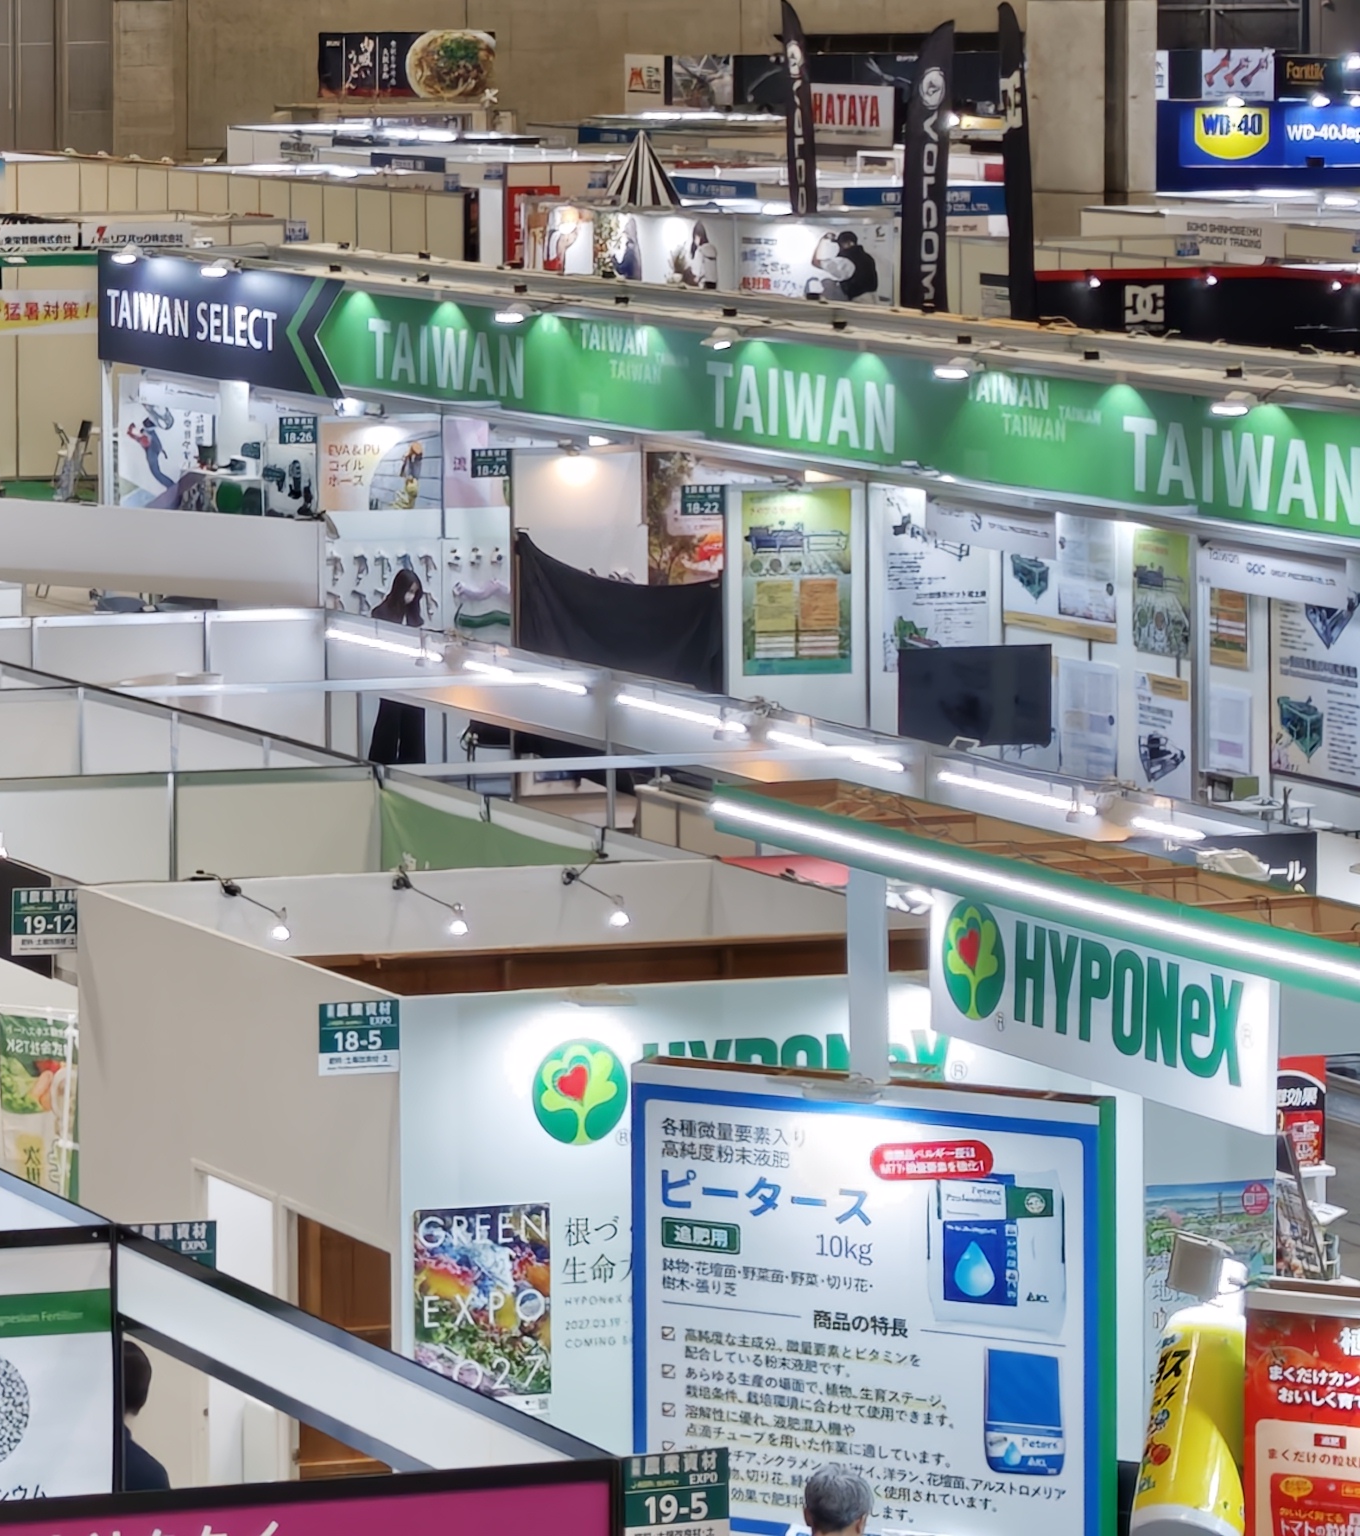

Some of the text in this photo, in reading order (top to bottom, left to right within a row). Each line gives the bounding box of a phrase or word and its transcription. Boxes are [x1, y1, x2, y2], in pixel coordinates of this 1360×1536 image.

[1287, 60, 1326, 81] Fanttik
[812, 92, 880, 127] HATAYA
[1201, 114, 1263, 135] WD-40
[106, 287, 278, 352] TAIWAN SELECT
[579, 321, 649, 358] TAIWAN
[367, 317, 525, 400] TAIWAN
[967, 370, 1049, 410] TAIWAN
[705, 361, 896, 455] TAIWAN
[284, 431, 313, 443] 18-26
[1001, 411, 1068, 442] TAIWAN
[328, 458, 364, 472] コイル
[476, 465, 507, 476] 18-24
[1122, 415, 1360, 528] TAIWAN
[328, 475, 364, 488] ホース
[687, 501, 719, 514] 18-22
[23, 914, 76, 934] 19-12
[368, 1016, 392, 1026] EXPO
[333, 1030, 382, 1052] 18-5
[662, 1117, 807, 1148] 各種微量要素入り
[661, 1140, 791, 1169] 高純度粉末液肥
[661, 1169, 873, 1227] ピータース
[418, 1209, 549, 1249] GREEN
[673, 1224, 728, 1248] 追肥用
[815, 1233, 874, 1266] 10kg
[422, 1287, 546, 1330] EXPO
[812, 1309, 909, 1338] 商品の特長
[564, 1337, 618, 1349] COMING
[689, 1472, 719, 1485] EXPO
[644, 1491, 709, 1525] 19-5
